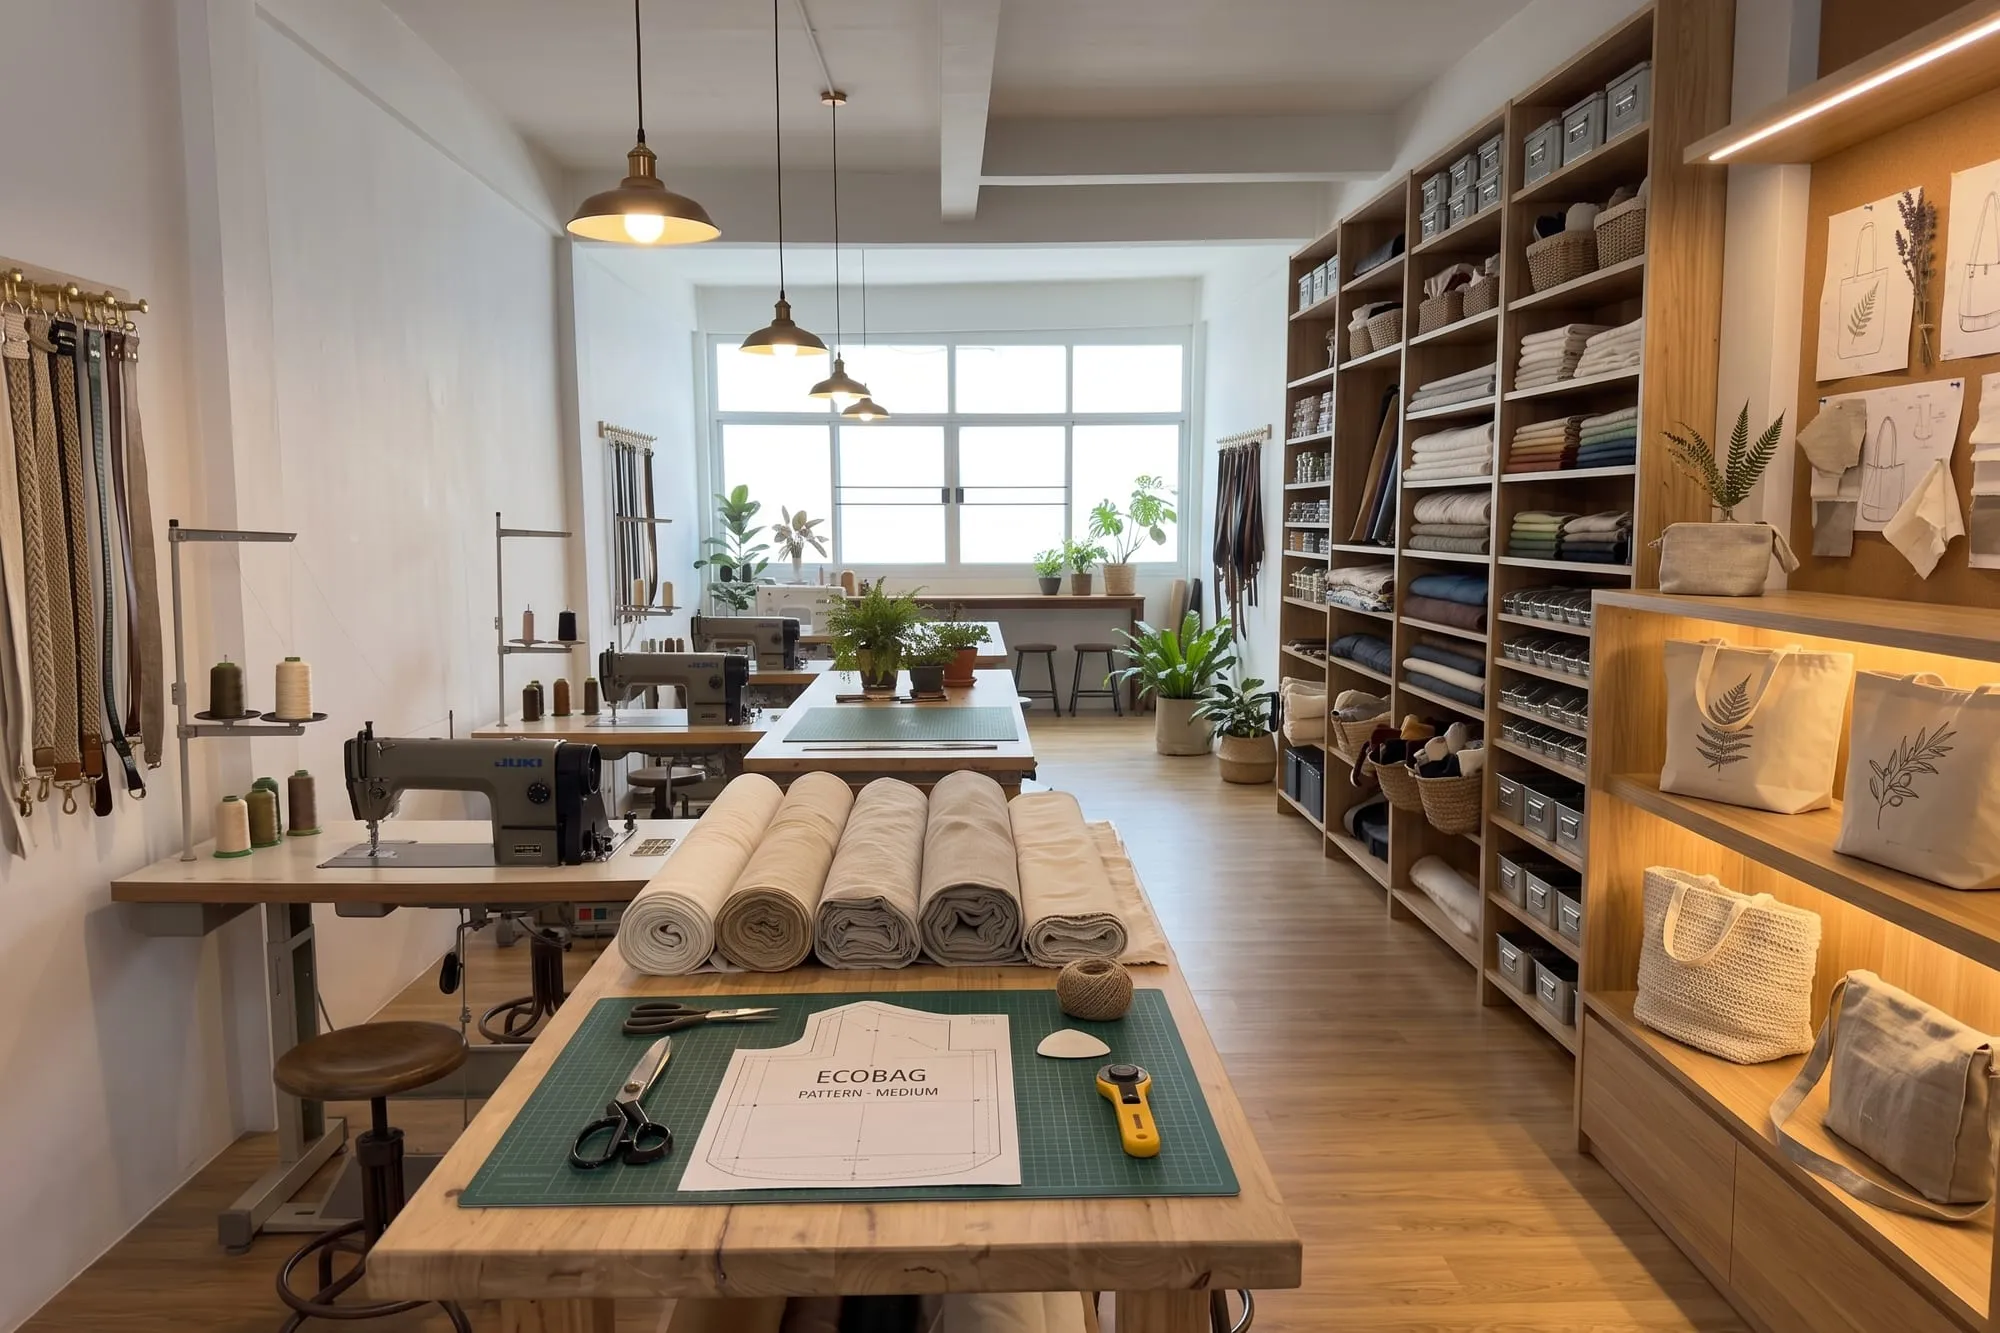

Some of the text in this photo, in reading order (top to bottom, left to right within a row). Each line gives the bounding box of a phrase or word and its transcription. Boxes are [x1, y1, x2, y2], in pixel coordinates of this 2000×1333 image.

[494, 757, 542, 767] JUKI
[817, 1069, 926, 1084] ECOBAG
[798, 1088, 863, 1099] PATTERN
[876, 1087, 938, 1097] MEDIUM
